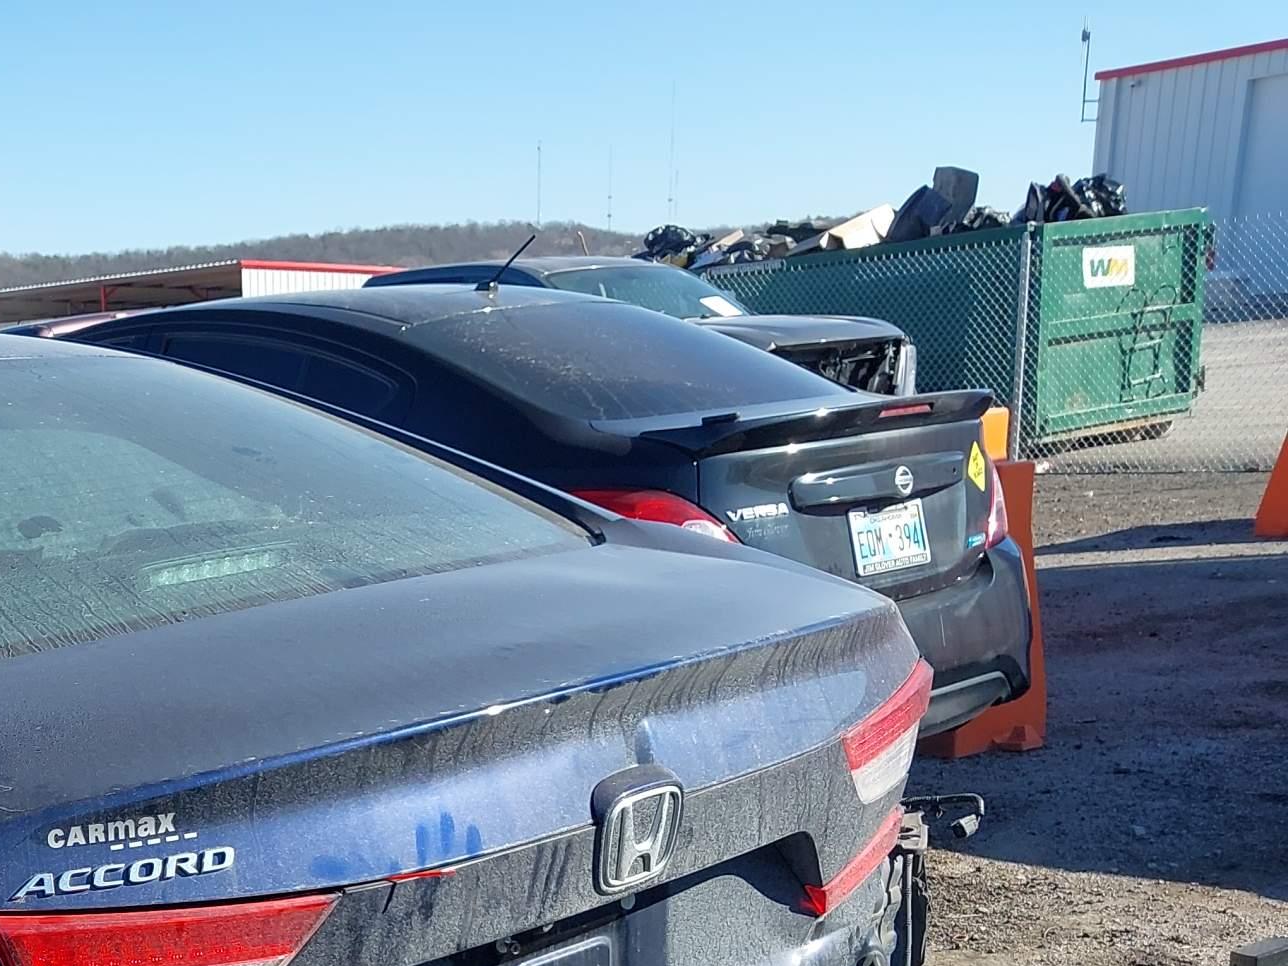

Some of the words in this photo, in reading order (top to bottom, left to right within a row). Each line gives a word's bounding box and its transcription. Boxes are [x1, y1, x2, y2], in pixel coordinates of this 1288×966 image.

[1089, 257, 1128, 278] WM
[726, 502, 790, 522] VERSA
[895, 520, 921, 551] 394
[11, 846, 236, 900] ACCORD
